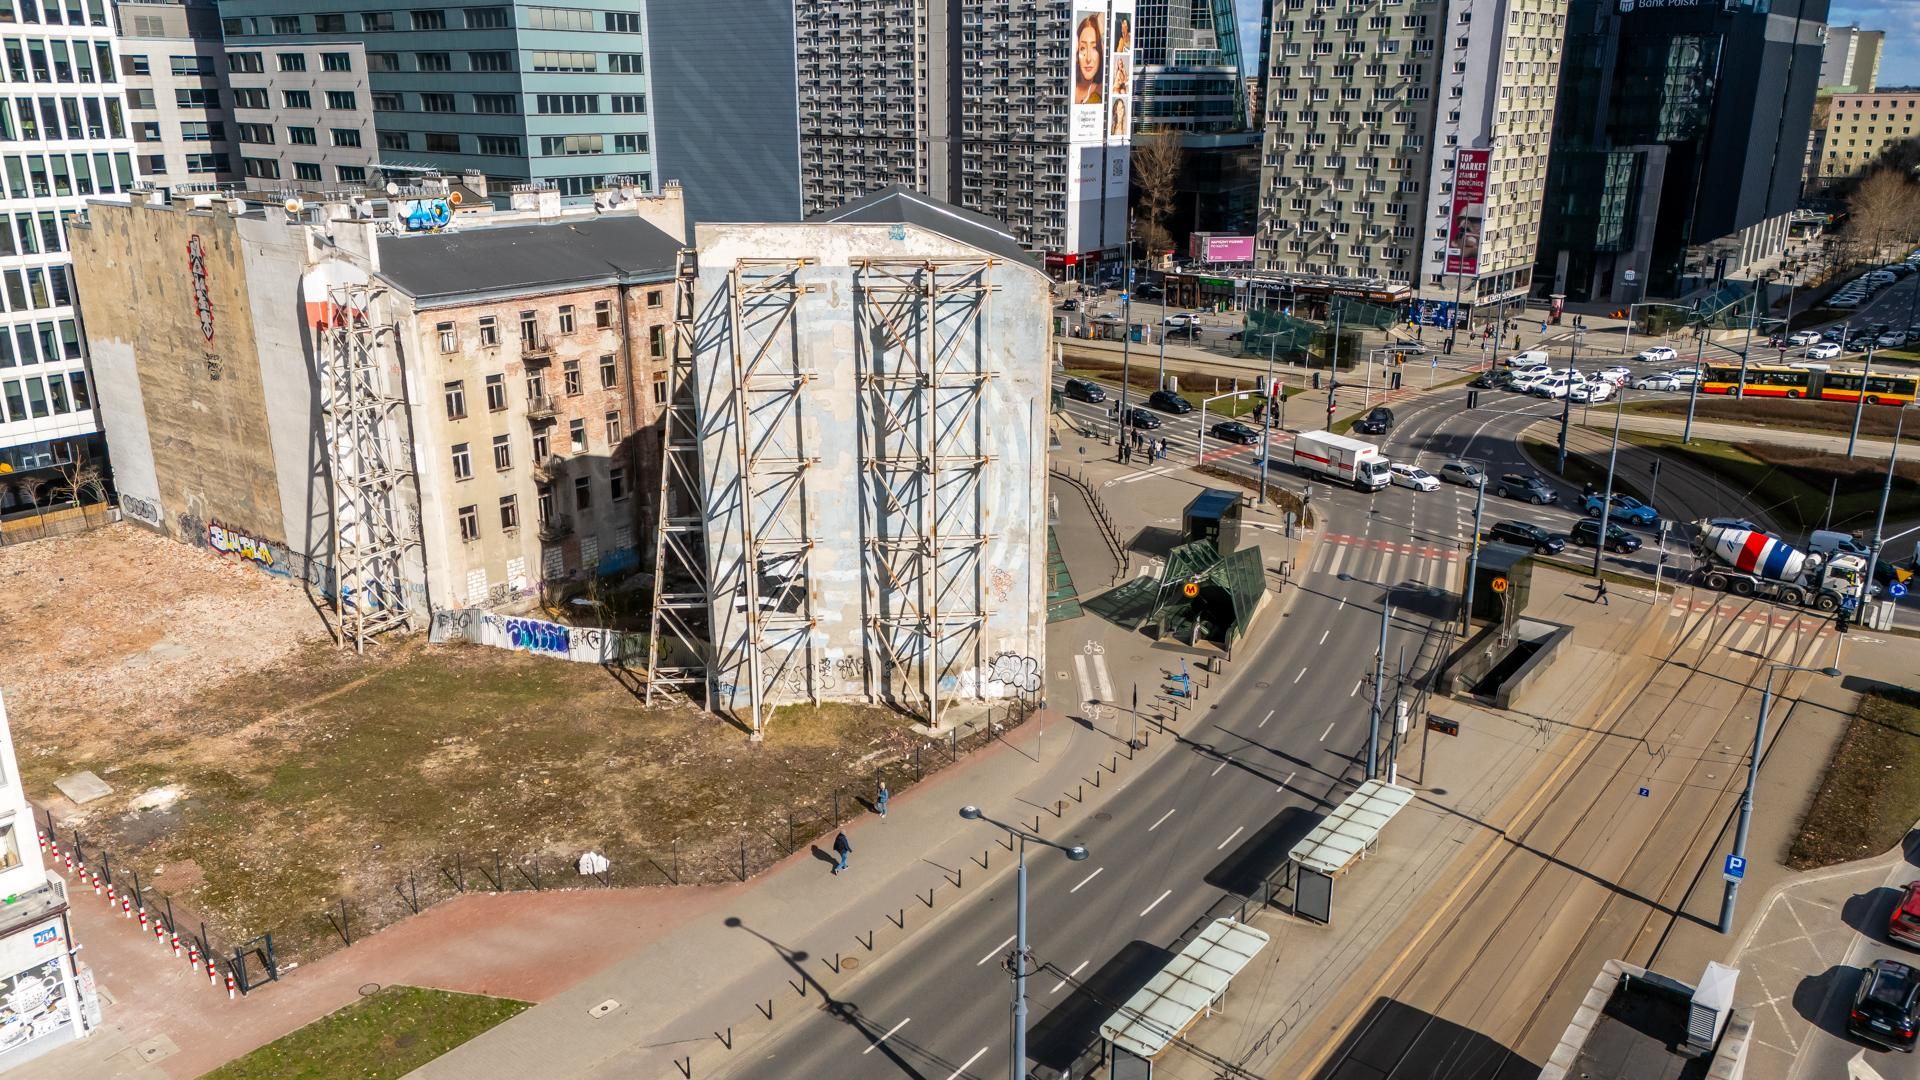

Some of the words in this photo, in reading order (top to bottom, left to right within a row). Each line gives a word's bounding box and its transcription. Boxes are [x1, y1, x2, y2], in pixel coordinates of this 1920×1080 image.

[1638, 0, 1664, 8] Bank
[1461, 154, 1474, 162] TOP
[1459, 162, 1487, 171] MARKET
[1729, 857, 1743, 870] P
